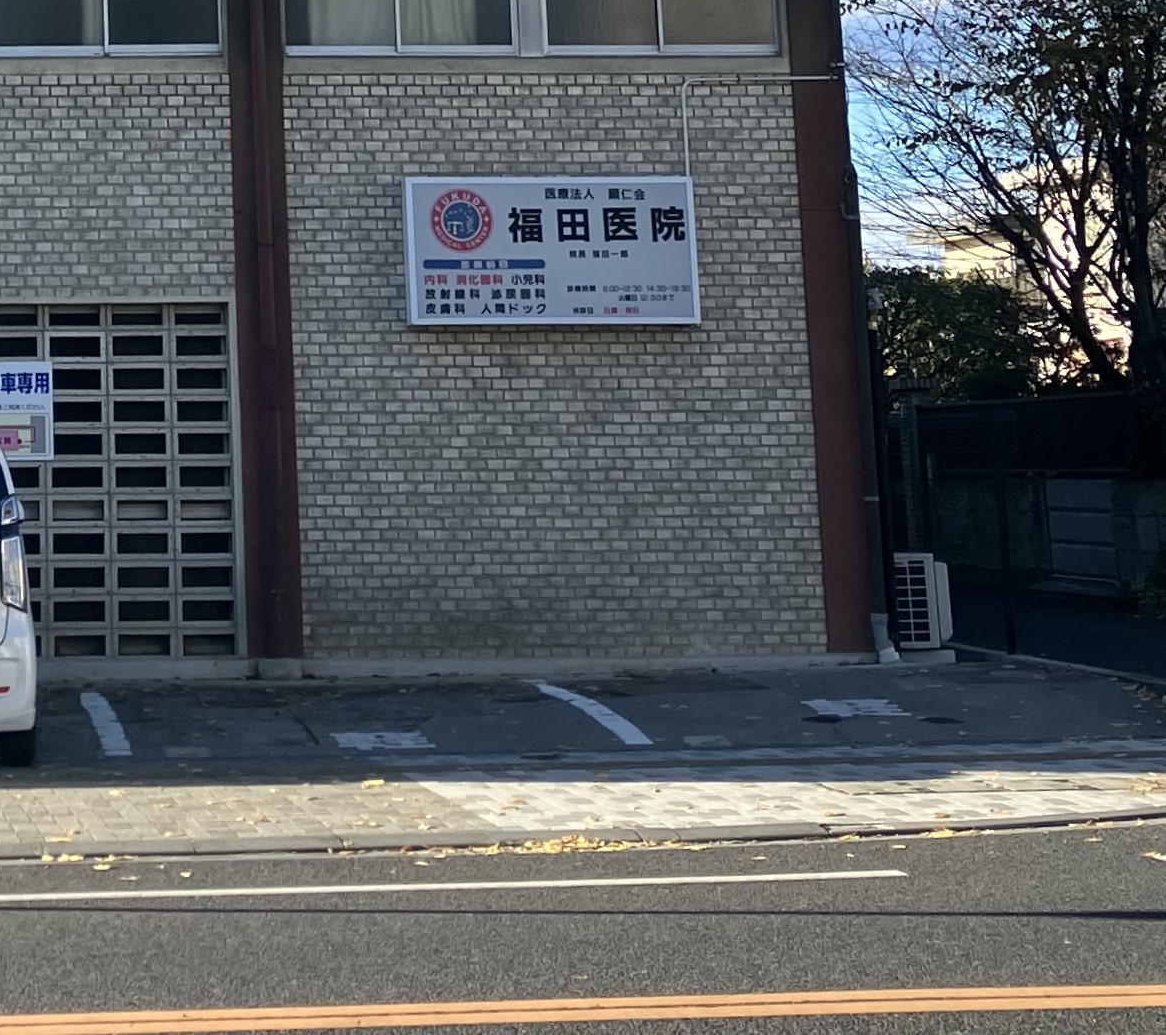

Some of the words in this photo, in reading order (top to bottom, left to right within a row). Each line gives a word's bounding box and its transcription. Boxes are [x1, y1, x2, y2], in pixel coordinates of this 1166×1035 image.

[544, 187, 595, 201] 医療法人
[434, 191, 488, 214] FUKUDA
[508, 206, 687, 243] 福田医院
[424, 274, 448, 285] 内科
[511, 274, 546, 285] 小児科
[426, 303, 465, 315] 皮膚科
[481, 303, 547, 315] 人間ドック
